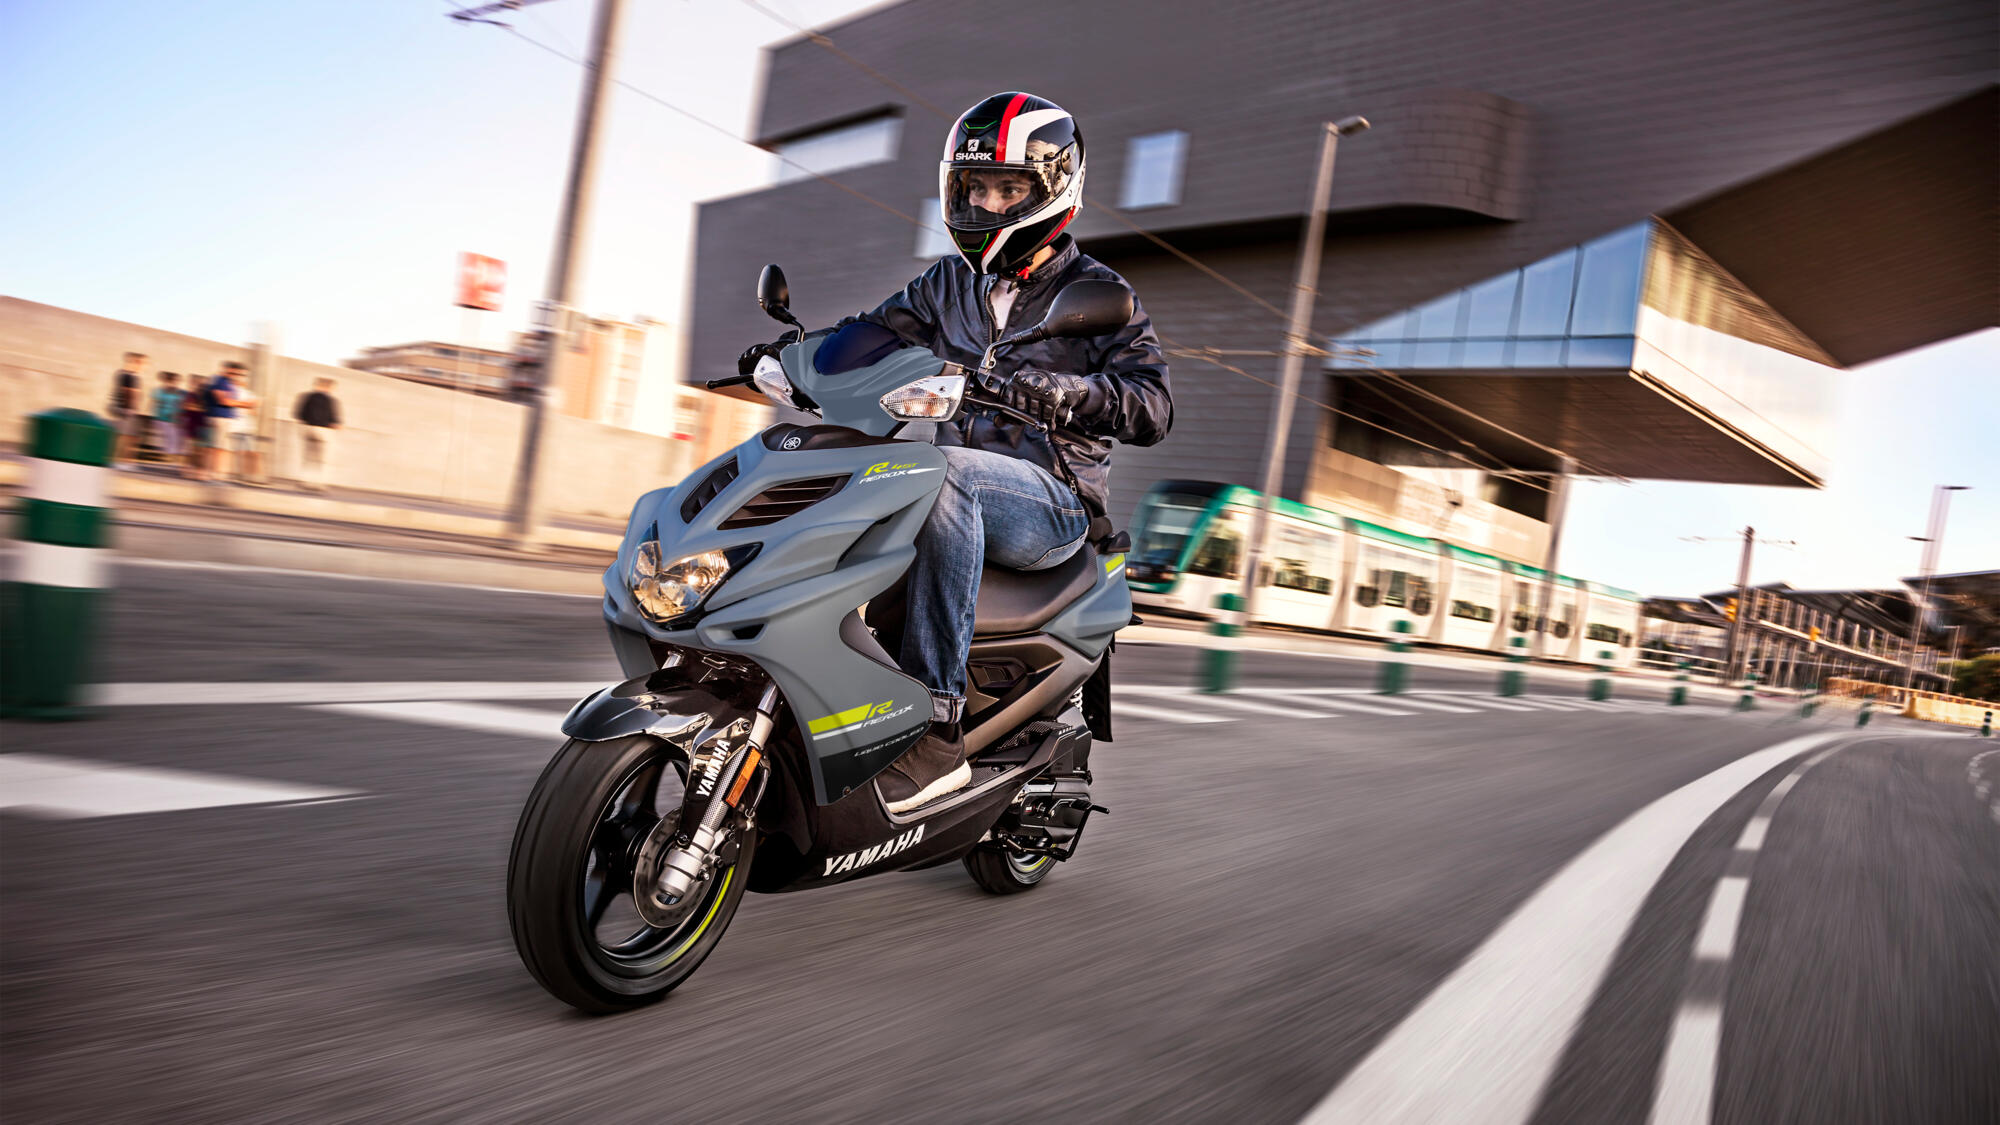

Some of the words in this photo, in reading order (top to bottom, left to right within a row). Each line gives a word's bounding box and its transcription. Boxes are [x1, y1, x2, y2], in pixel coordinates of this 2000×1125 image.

[955, 152, 993, 161] SHARK
[859, 469, 907, 485] AEROX
[864, 461, 890, 476] R
[863, 704, 914, 728] AEROX
[868, 700, 894, 719] R
[696, 739, 731, 797] YAMAHA
[822, 823, 926, 877] YAMAHA
